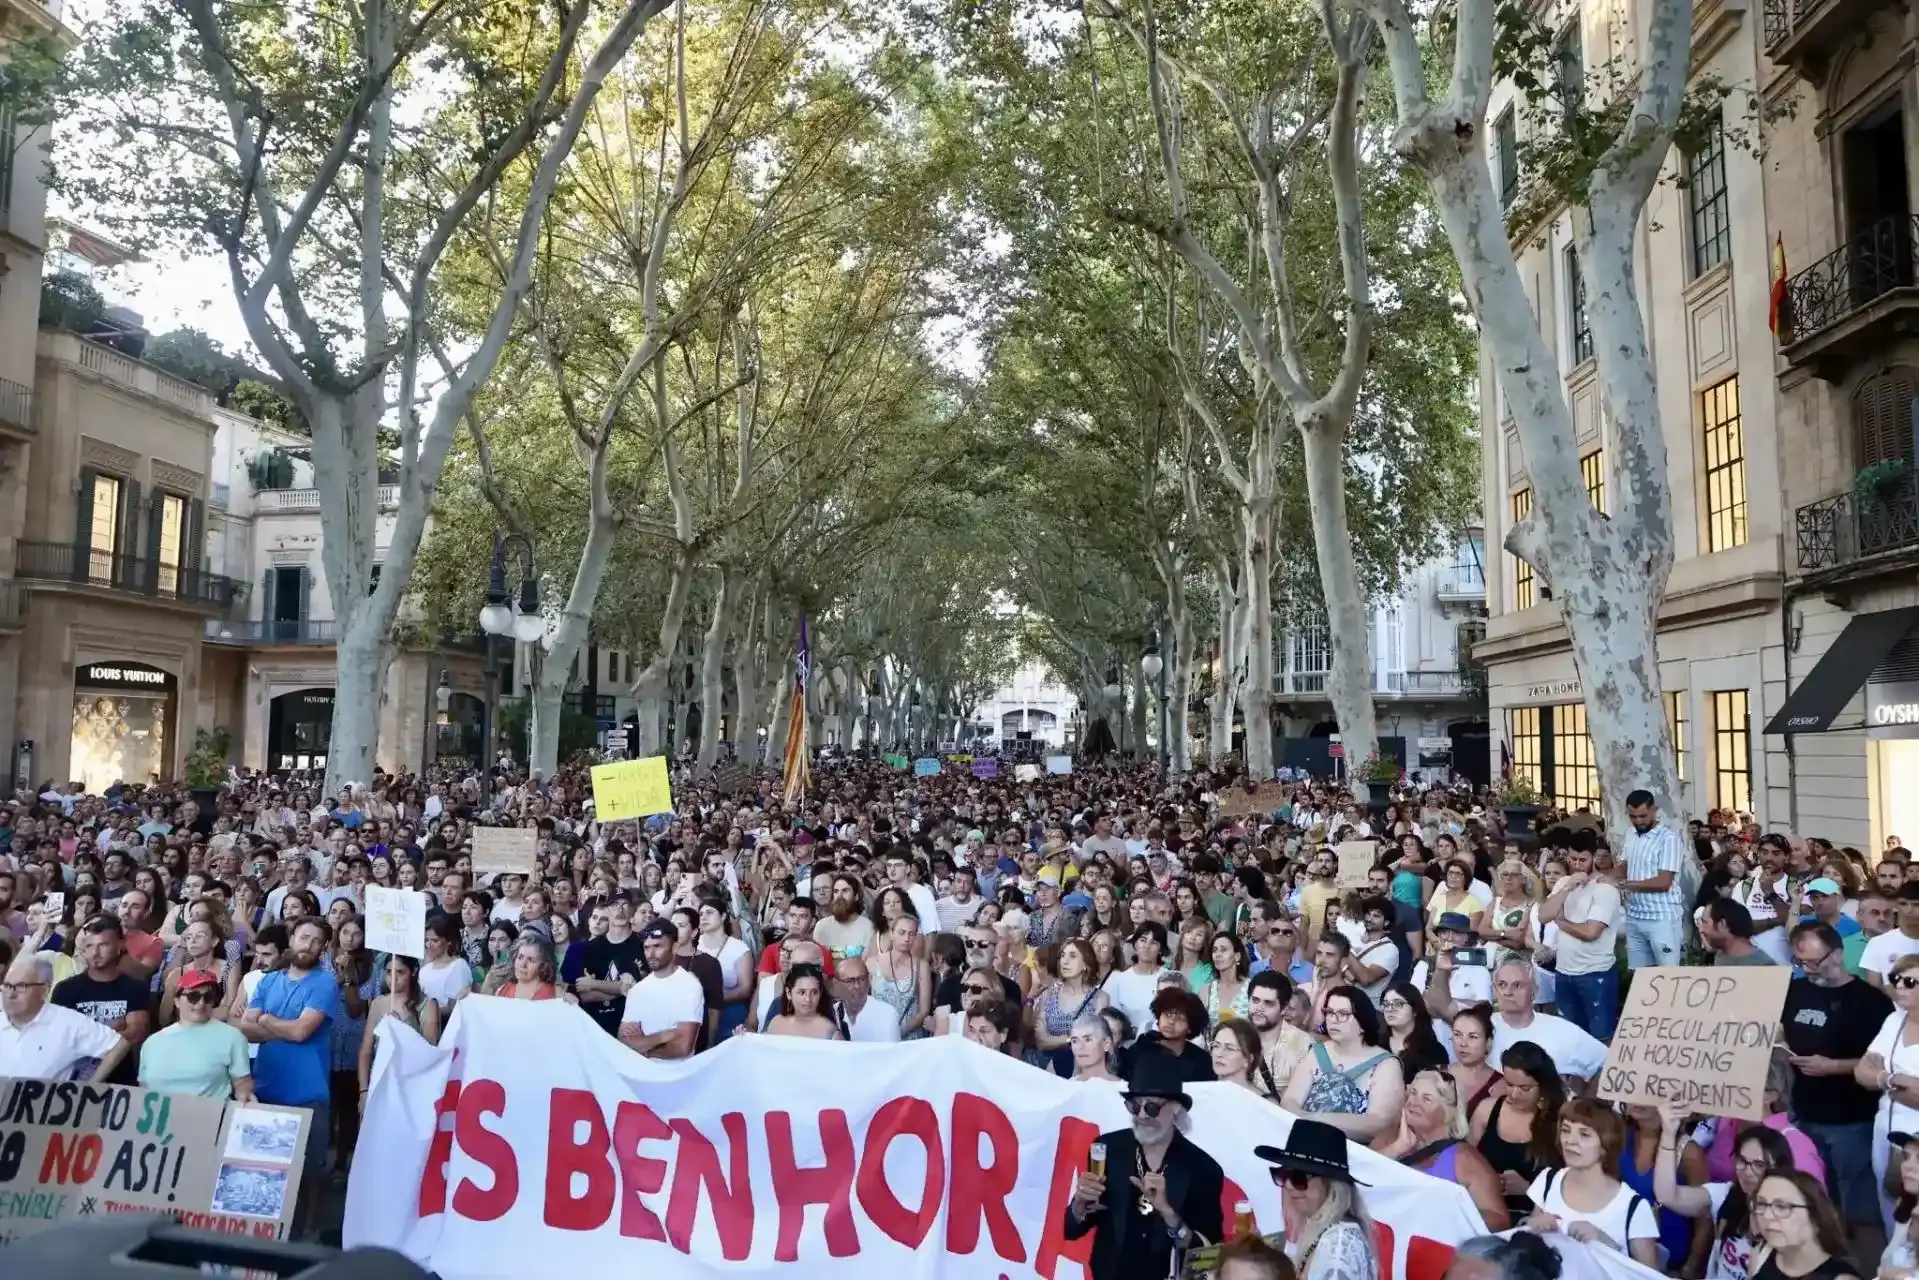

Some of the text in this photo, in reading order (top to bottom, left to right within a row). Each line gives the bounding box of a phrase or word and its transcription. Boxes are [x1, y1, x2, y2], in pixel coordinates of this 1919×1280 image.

[90, 667, 164, 683] LOUIS VUITTON
[1528, 684, 1552, 697] ZARA
[1788, 716, 1819, 726] OYSHO
[1641, 974, 1737, 1011] STOP
[1618, 1016, 1776, 1049] ESPECULATION
[1618, 1043, 1636, 1063] IN
[1643, 1044, 1735, 1073] HOUSING
[1602, 1066, 1752, 1110] SOS RESIDENTS
[38, 1132, 103, 1185] NO
